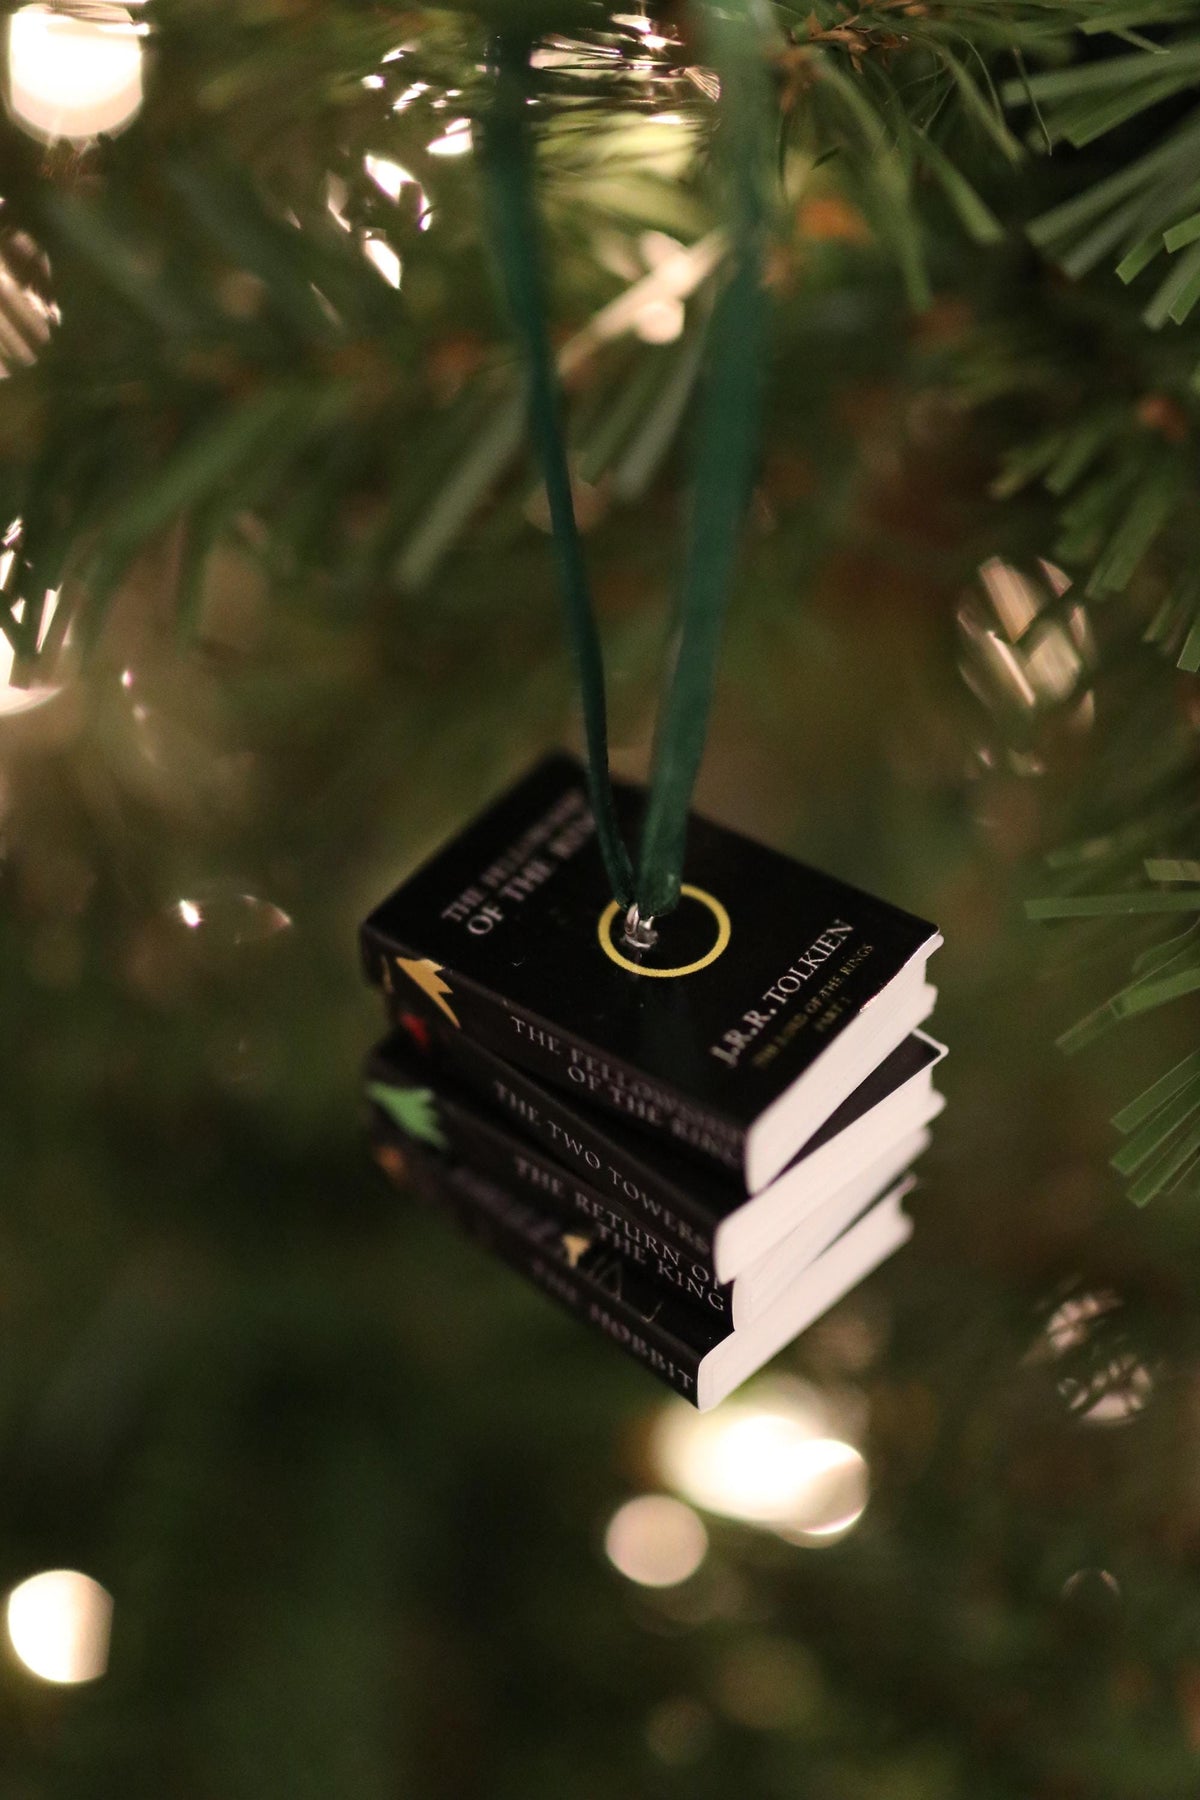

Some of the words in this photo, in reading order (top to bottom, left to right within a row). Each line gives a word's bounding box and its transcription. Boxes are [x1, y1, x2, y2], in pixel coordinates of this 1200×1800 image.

[762, 917, 855, 1005] TOLKIEN
[510, 1015, 561, 1056] THE
[567, 1064, 602, 1091] OF
[609, 1084, 663, 1127] THE
[493, 1079, 540, 1126] THE
[548, 1119, 601, 1170] TWO
[607, 1165, 711, 1256] TOWERS
[575, 1191, 682, 1267] RETURN
[597, 1222, 647, 1266] THE
[657, 1259, 726, 1312] KING
